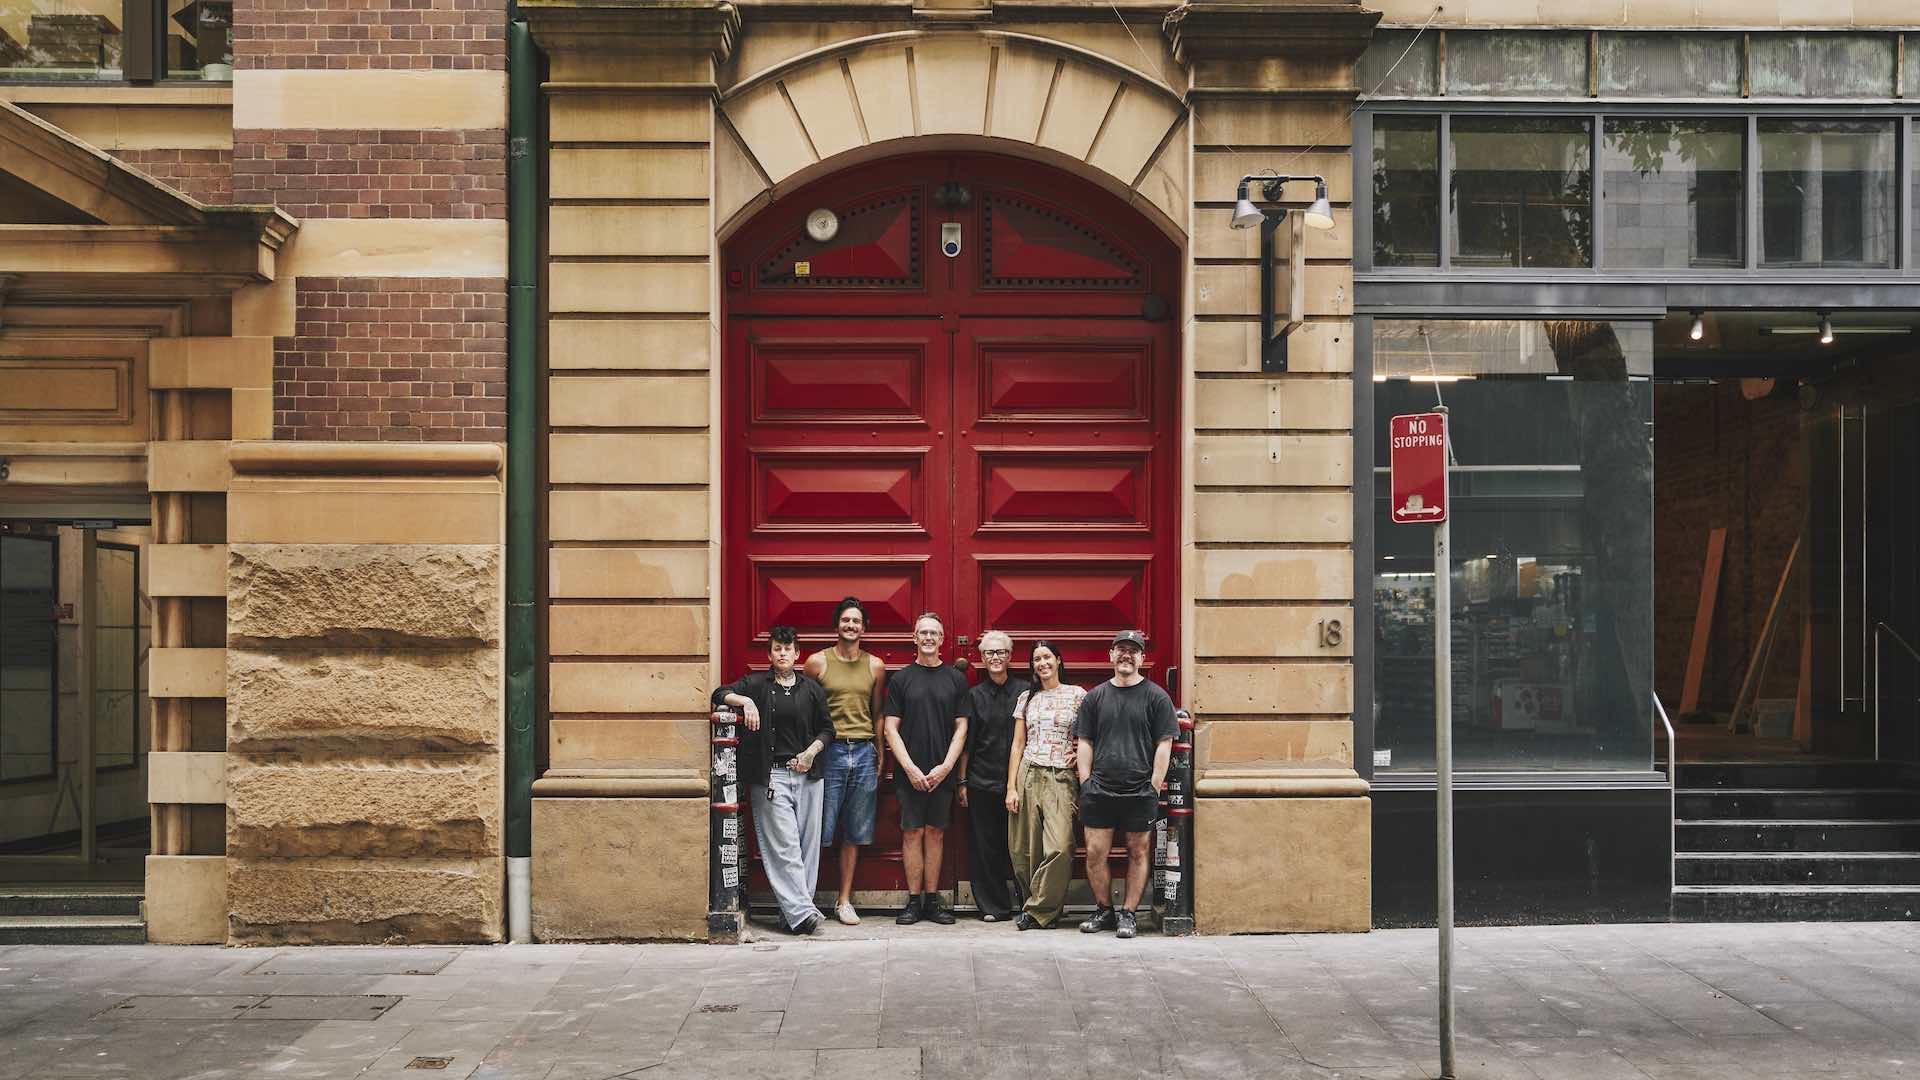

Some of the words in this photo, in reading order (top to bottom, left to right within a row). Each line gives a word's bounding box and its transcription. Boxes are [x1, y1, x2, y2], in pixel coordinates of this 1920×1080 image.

[1409, 420, 1427, 434] NO
[1394, 434, 1443, 448] STOPPING
[1318, 618, 1342, 648] 18
